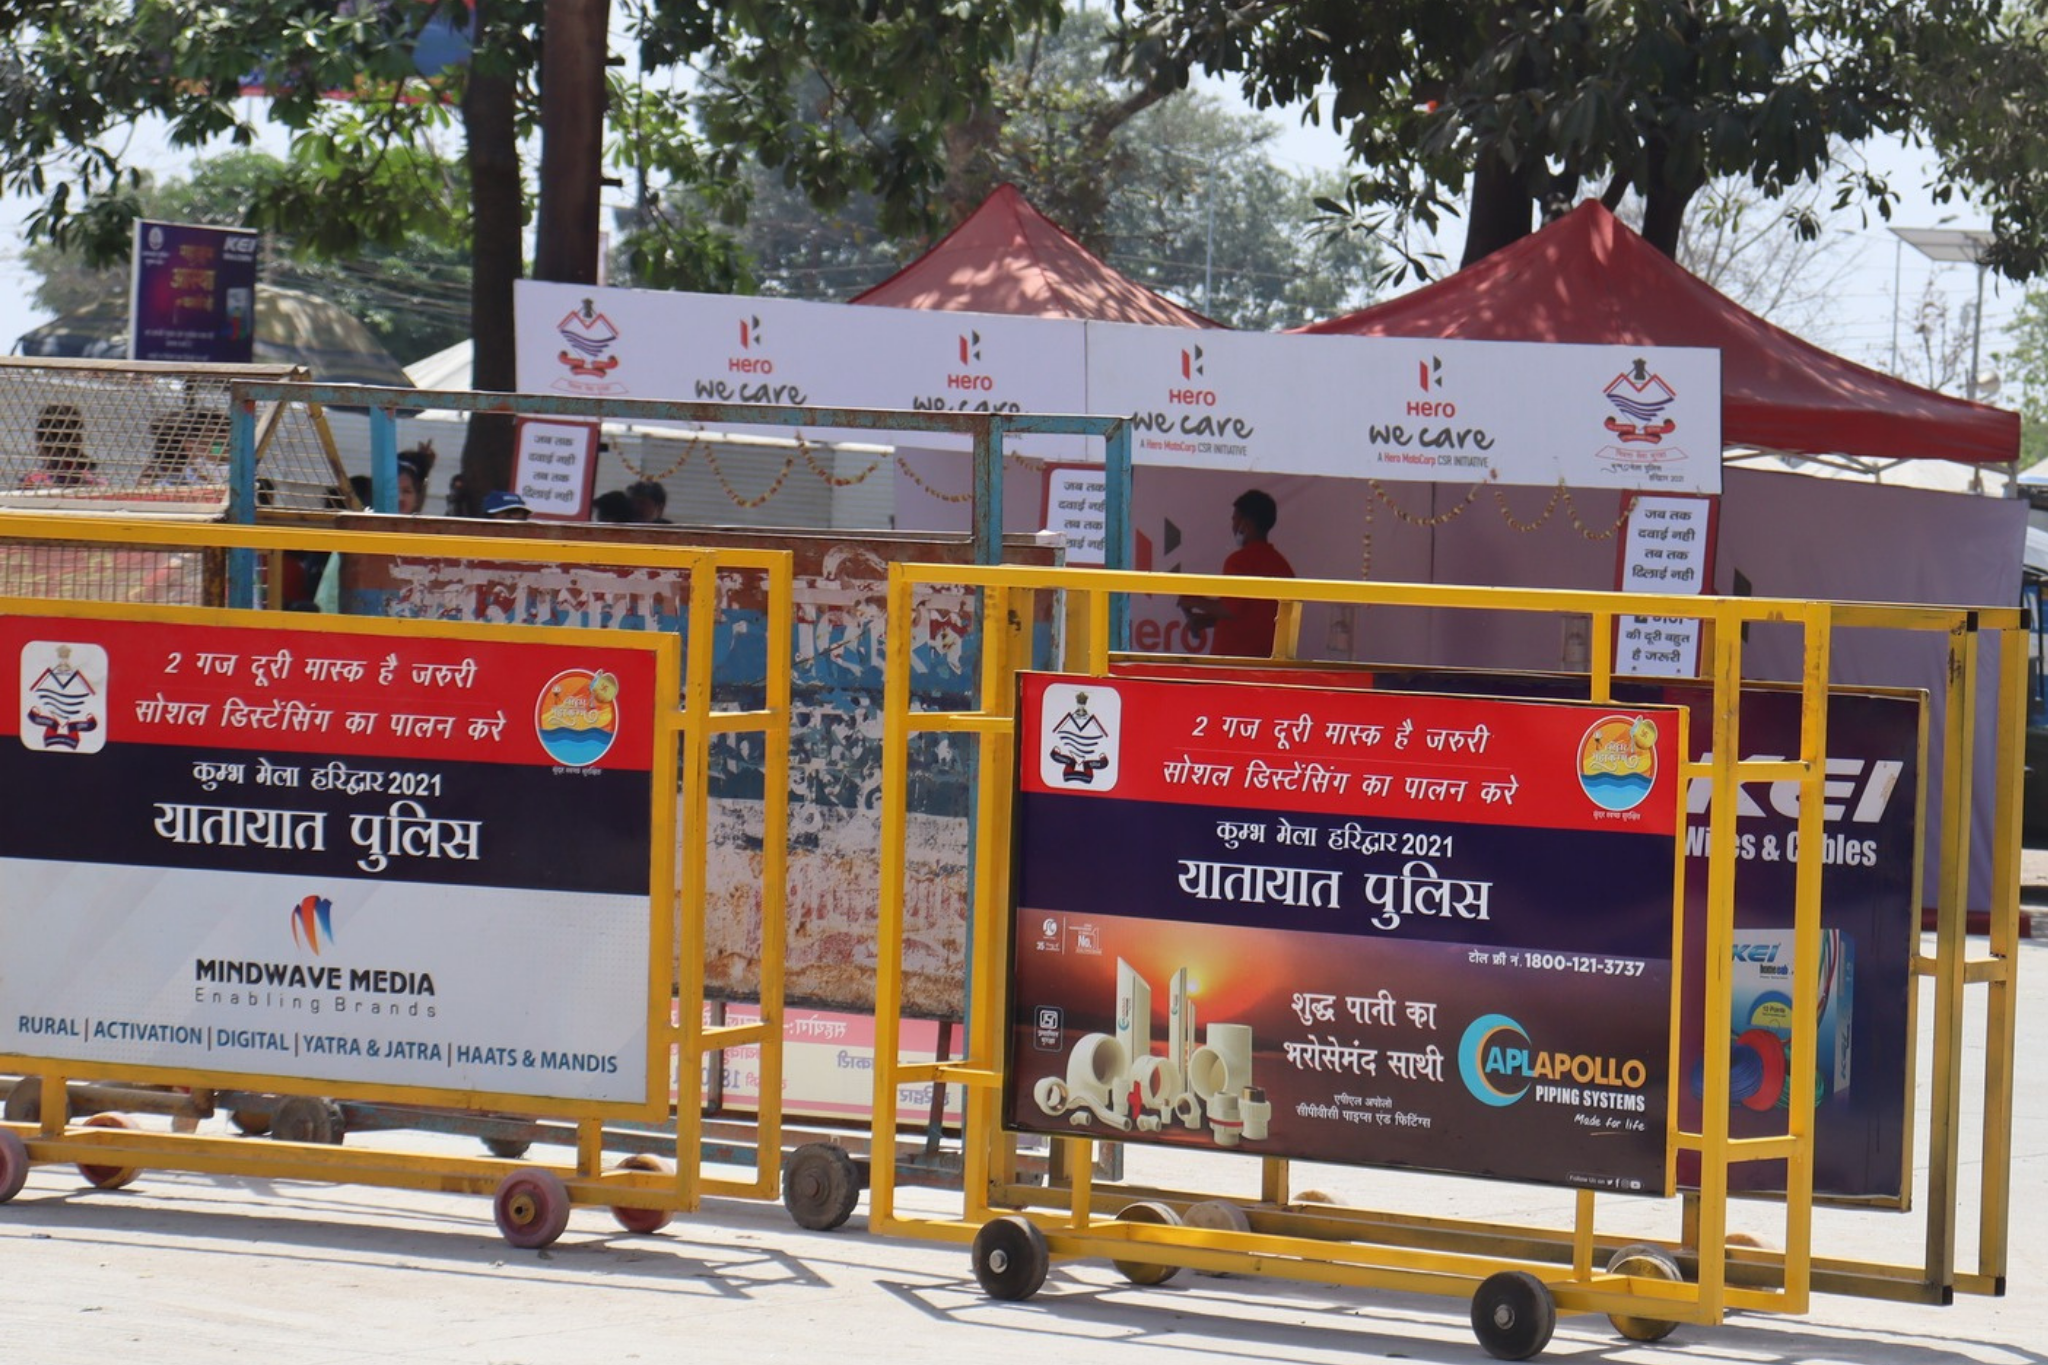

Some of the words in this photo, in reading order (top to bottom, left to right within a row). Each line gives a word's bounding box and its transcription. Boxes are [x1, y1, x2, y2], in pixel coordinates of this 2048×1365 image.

[728, 358, 773, 375] Hero
[695, 379, 735, 402] we
[739, 382, 807, 405] care
[947, 374, 993, 391] Hero
[1168, 388, 1216, 406] Hero
[1406, 401, 1456, 418] Hero
[1131, 411, 1175, 433] we
[1180, 415, 1254, 439] care
[1369, 424, 1413, 446] we
[1418, 427, 1495, 450] care
[1198, 442, 1212, 453] CSR
[1213, 443, 1248, 456] INITIATIVE
[1437, 455, 1452, 466] CSR
[1453, 456, 1489, 468] INITIATIVE
[1058, 498, 1087, 512] दवाई
[1644, 509, 1664, 520] जब
[1669, 510, 1692, 521] तक
[1638, 526, 1669, 541] दवाई
[1644, 548, 1663, 559] तब
[1666, 549, 1690, 561] तक
[1130, 617, 1208, 652] ero
[1625, 628, 1641, 640] की
[1644, 629, 1662, 645] दूरी
[164, 652, 182, 674] 2
[196, 651, 239, 677] गज
[251, 648, 293, 687] दूरी
[304, 656, 367, 683] मास्क
[378, 652, 398, 685] है
[1632, 647, 1642, 661] है
[135, 692, 210, 726] सोशल
[345, 709, 377, 735] का
[390, 711, 456, 740] पालन
[467, 709, 506, 742] करे
[1191, 715, 1209, 737] 2
[1221, 715, 1262, 740] गज
[1274, 713, 1314, 750] दूरी
[1325, 722, 1384, 747] मास्क
[1394, 718, 1413, 750] है
[192, 760, 246, 791] कुम्भ
[255, 757, 300, 787] मेला
[310, 761, 385, 796] हरिद्वार
[387, 771, 441, 797] 2021
[1163, 754, 1234, 787] सोशल
[1362, 772, 1394, 797] का
[1404, 776, 1468, 802] पालन
[1480, 774, 1520, 805] करे
[1687, 752, 1904, 823] KEI
[153, 802, 328, 851] यातायात
[349, 800, 483, 873] पुलिस
[1216, 819, 1266, 850] कुम्भ
[1276, 817, 1318, 847] मेला
[1328, 822, 1398, 855] हरिद्वार
[1401, 832, 1453, 858] 2021
[1685, 826, 1756, 860] Wis
[1761, 831, 1780, 862] &
[1786, 831, 1877, 867] Cbles
[1177, 858, 1343, 909] यातायात
[1364, 860, 1493, 930] पुलिस
[1468, 949, 1488, 964] टोल
[1492, 952, 1507, 966] फ्री
[1524, 952, 1645, 977] 1800-121-3737
[1732, 942, 1781, 962] KEI
[195, 958, 342, 990] MINDWAVE
[349, 969, 436, 996] MEDIA
[195, 987, 321, 1014] Enabling
[334, 996, 437, 1019] Brands
[1291, 992, 1336, 1026] शुद्ध
[1345, 989, 1397, 1027] पानी
[1405, 1001, 1437, 1030] का
[18, 1014, 80, 1037] RURAL
[93, 1019, 202, 1046] ACTIVATION
[216, 1028, 290, 1051] DIGITAL
[303, 1035, 361, 1056] YATRA
[366, 1040, 381, 1057] &
[383, 1040, 442, 1062] JATRA
[456, 1045, 517, 1068] HAATS
[522, 1050, 535, 1068] &
[540, 1052, 618, 1074] MANDIS
[1283, 1034, 1378, 1077] भरोसेमंद
[1386, 1044, 1444, 1082] साथी
[1535, 1084, 1580, 1106] PIPING
[1582, 1089, 1645, 1112] SYSTEMS
[1574, 1113, 1601, 1128] Made
[1605, 1116, 1621, 1129] for
[1625, 1118, 1645, 1132] life
